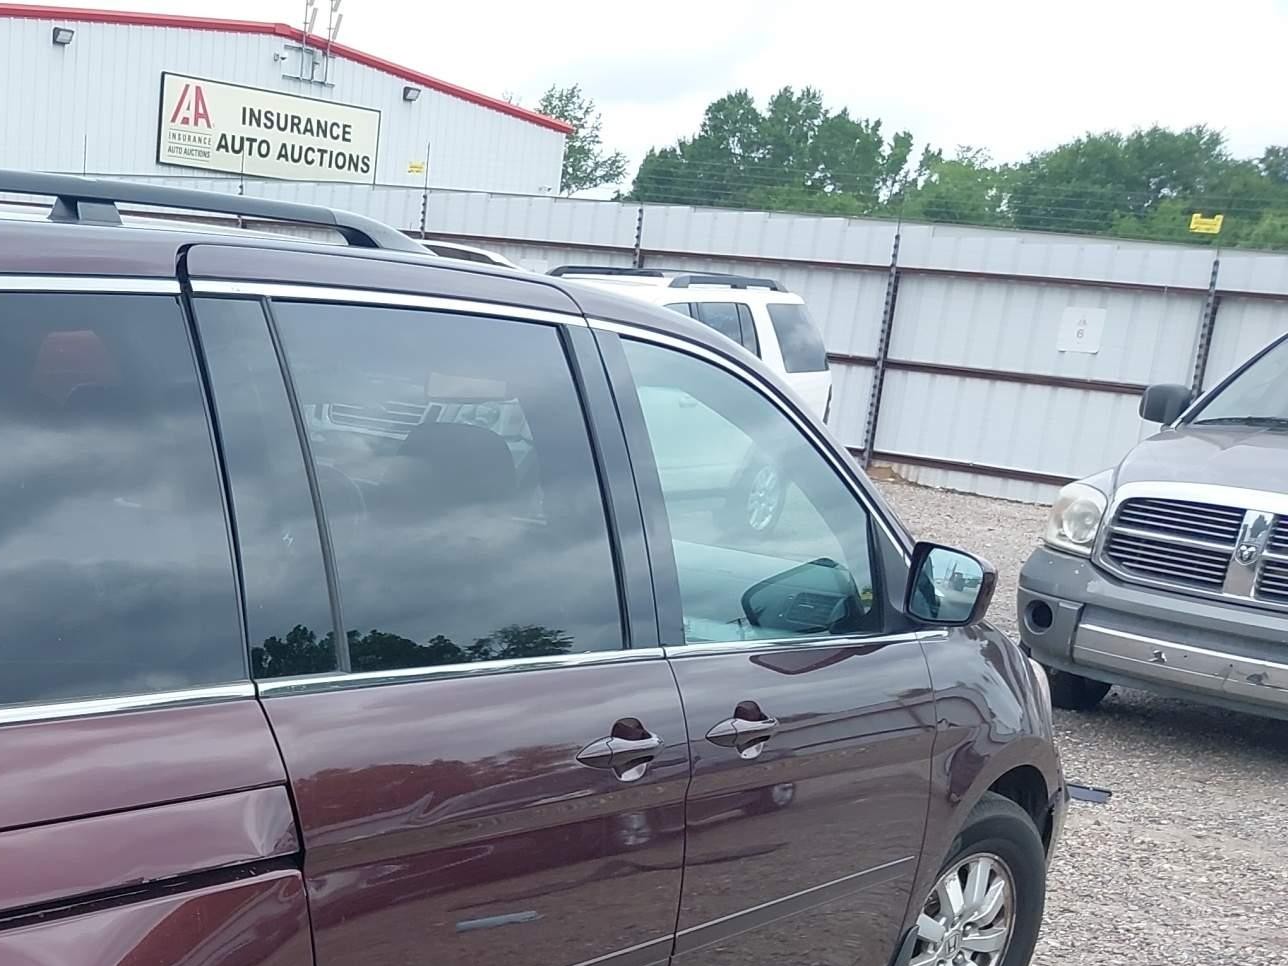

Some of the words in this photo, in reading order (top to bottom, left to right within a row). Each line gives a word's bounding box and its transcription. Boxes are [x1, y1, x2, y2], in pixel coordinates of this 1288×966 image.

[241, 106, 352, 143] INSURANCE
[168, 131, 212, 146] INSURANCE
[167, 145, 183, 154] AUTO
[183, 148, 210, 159] AUCTIONS
[215, 133, 271, 158] AUTO
[276, 142, 371, 174] AUCTIONS
